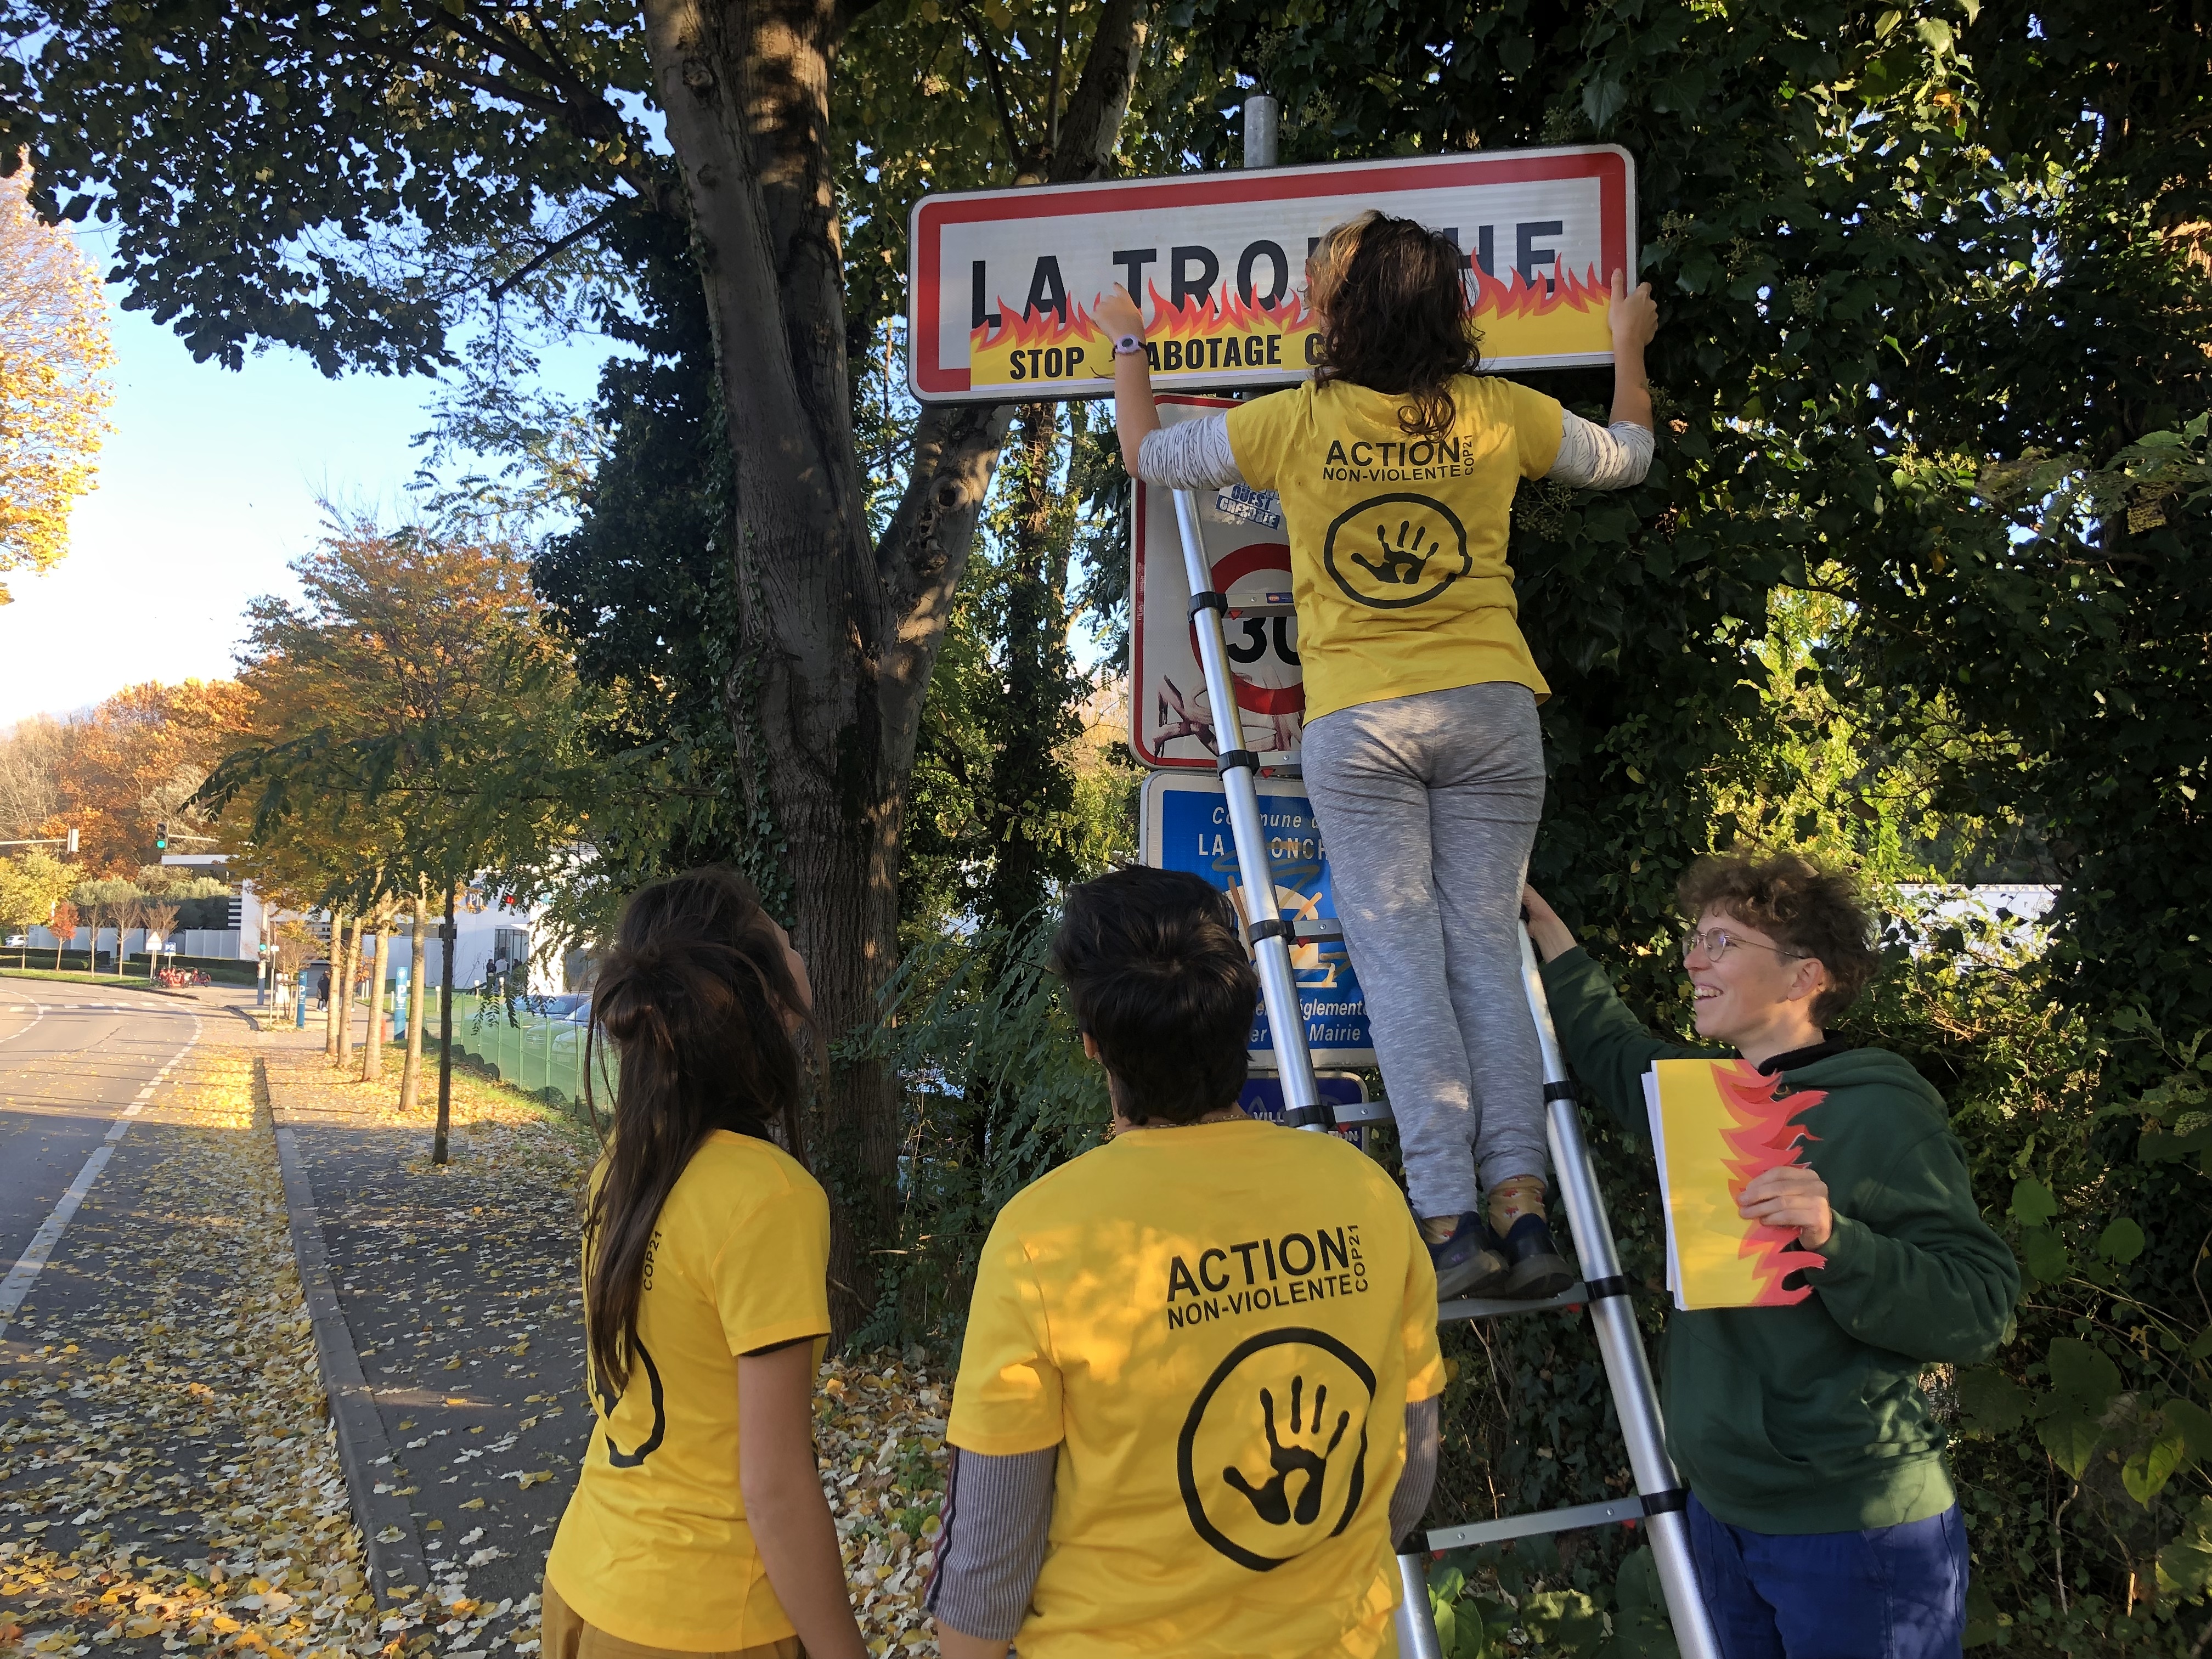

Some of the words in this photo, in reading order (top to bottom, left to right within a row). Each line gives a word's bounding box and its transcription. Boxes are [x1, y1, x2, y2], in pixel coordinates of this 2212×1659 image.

[972, 256, 1067, 329] LA
[1010, 346, 1084, 380] STOP
[1148, 334, 1282, 371] ABOTAGE
[1325, 437, 1460, 467] ACTION
[1462, 435, 1474, 476] COP21
[1323, 465, 1460, 482] NON-VIOLENTE
[1231, 485, 1273, 510] OUEST
[1199, 833, 1224, 856] LA
[1309, 1023, 1361, 1042] Mairie
[1254, 1111, 1284, 1123] VILL
[644, 1231, 662, 1291] COP21
[1167, 1226, 1350, 1302] ACTION
[1347, 1224, 1368, 1292] COP21
[1167, 1273, 1353, 1330] NON-VIOLENTE
